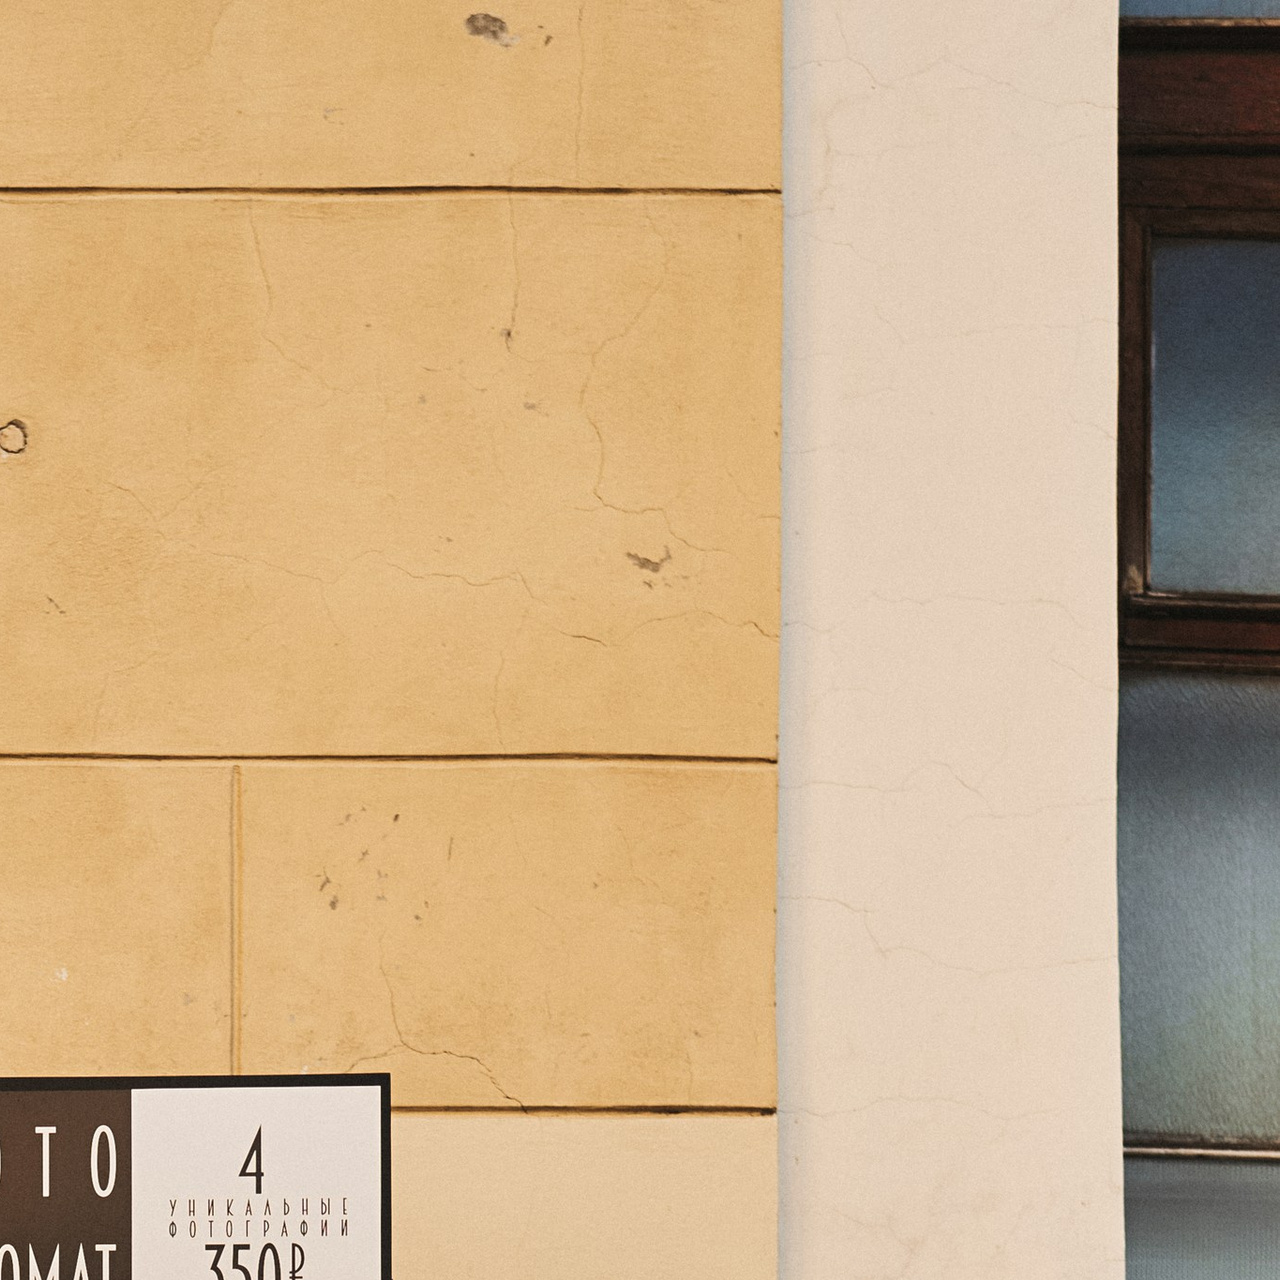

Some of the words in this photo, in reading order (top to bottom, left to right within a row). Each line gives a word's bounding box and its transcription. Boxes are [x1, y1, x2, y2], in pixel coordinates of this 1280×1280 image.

[238, 1124, 265, 1195] 4
[168, 1198, 348, 1217] УНИКАЛЬНЫЕ
[168, 1219, 349, 1238] ФОТОГРАФИИ
